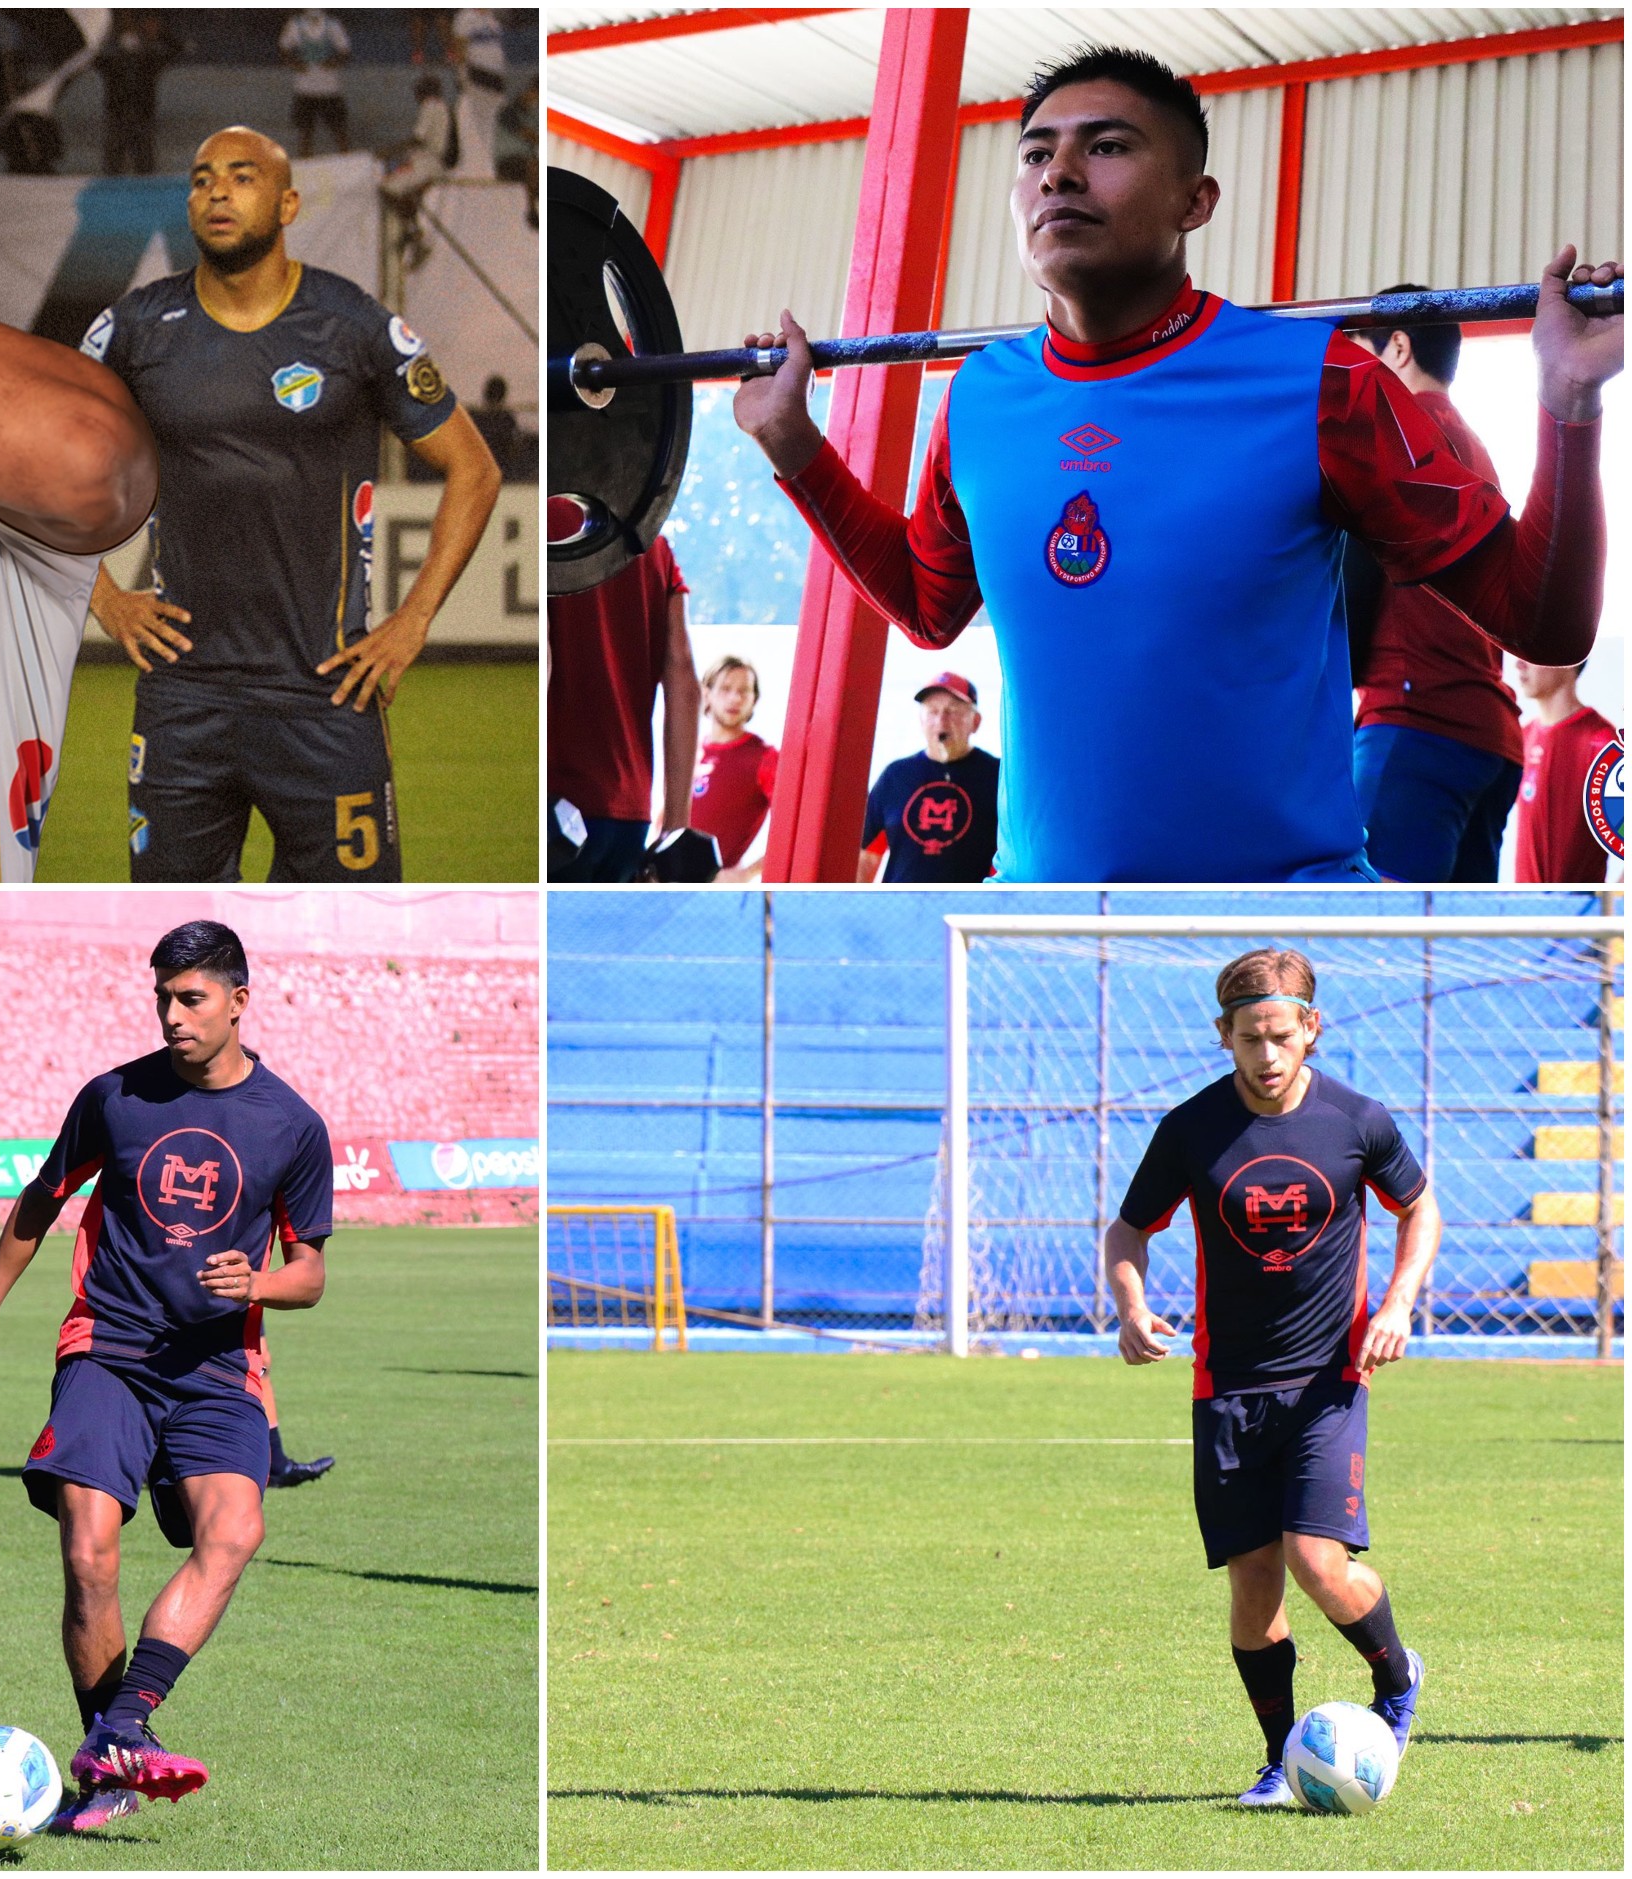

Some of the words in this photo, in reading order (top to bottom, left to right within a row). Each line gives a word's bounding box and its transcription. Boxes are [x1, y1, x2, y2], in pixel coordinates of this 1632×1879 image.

[1060, 459, 1111, 472] umbro
[335, 791, 379, 870] 5
[165, 1237, 193, 1247] umbro
